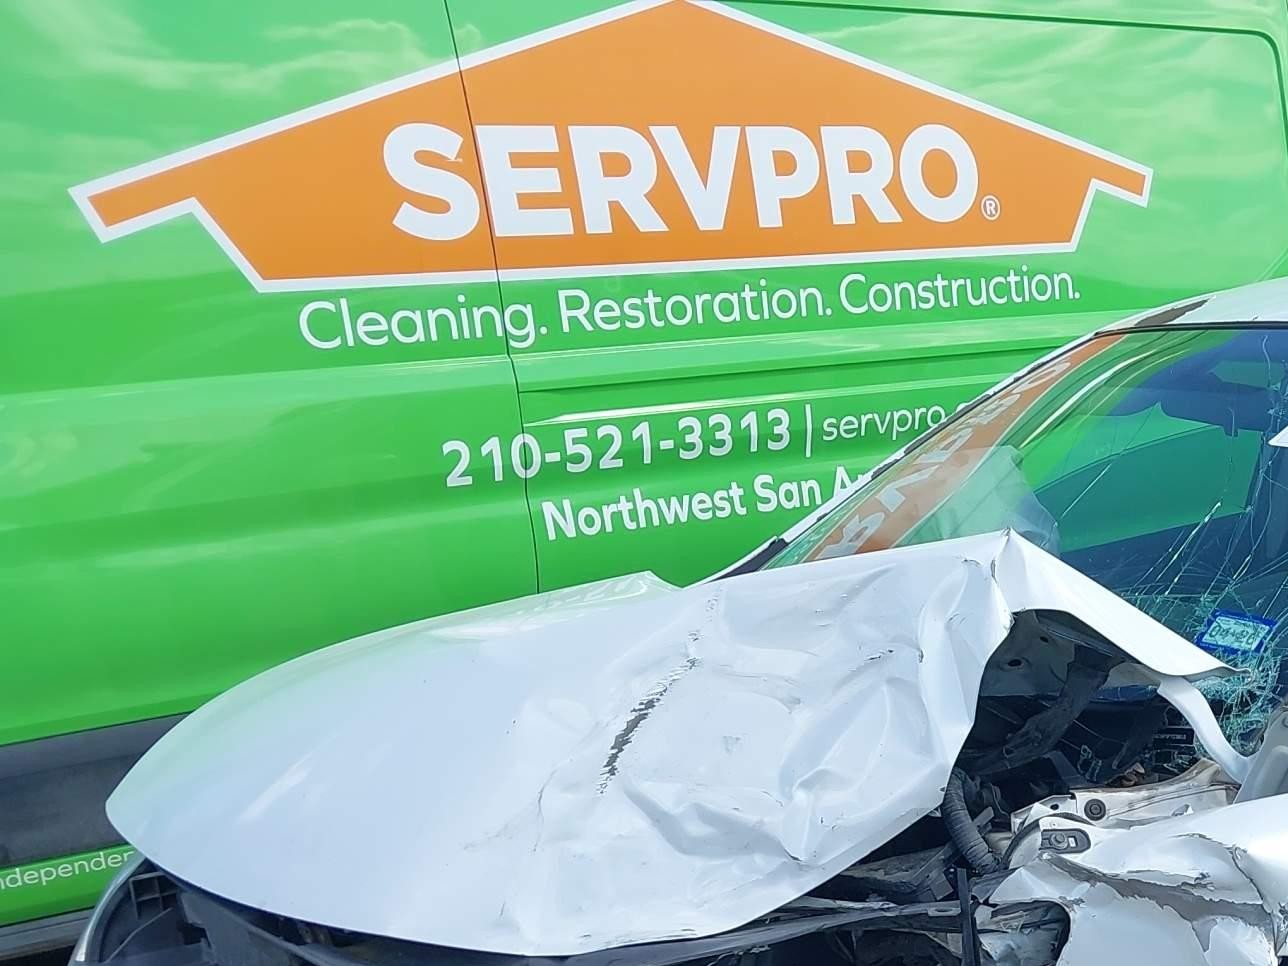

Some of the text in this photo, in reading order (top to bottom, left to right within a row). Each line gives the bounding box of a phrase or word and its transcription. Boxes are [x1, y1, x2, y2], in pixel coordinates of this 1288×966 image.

[299, 264, 1081, 349] Cleaning. Restoration. Construction.
[442, 407, 790, 487] 210-521-3313
[542, 481, 747, 540] Northwest
[753, 474, 822, 513] San
